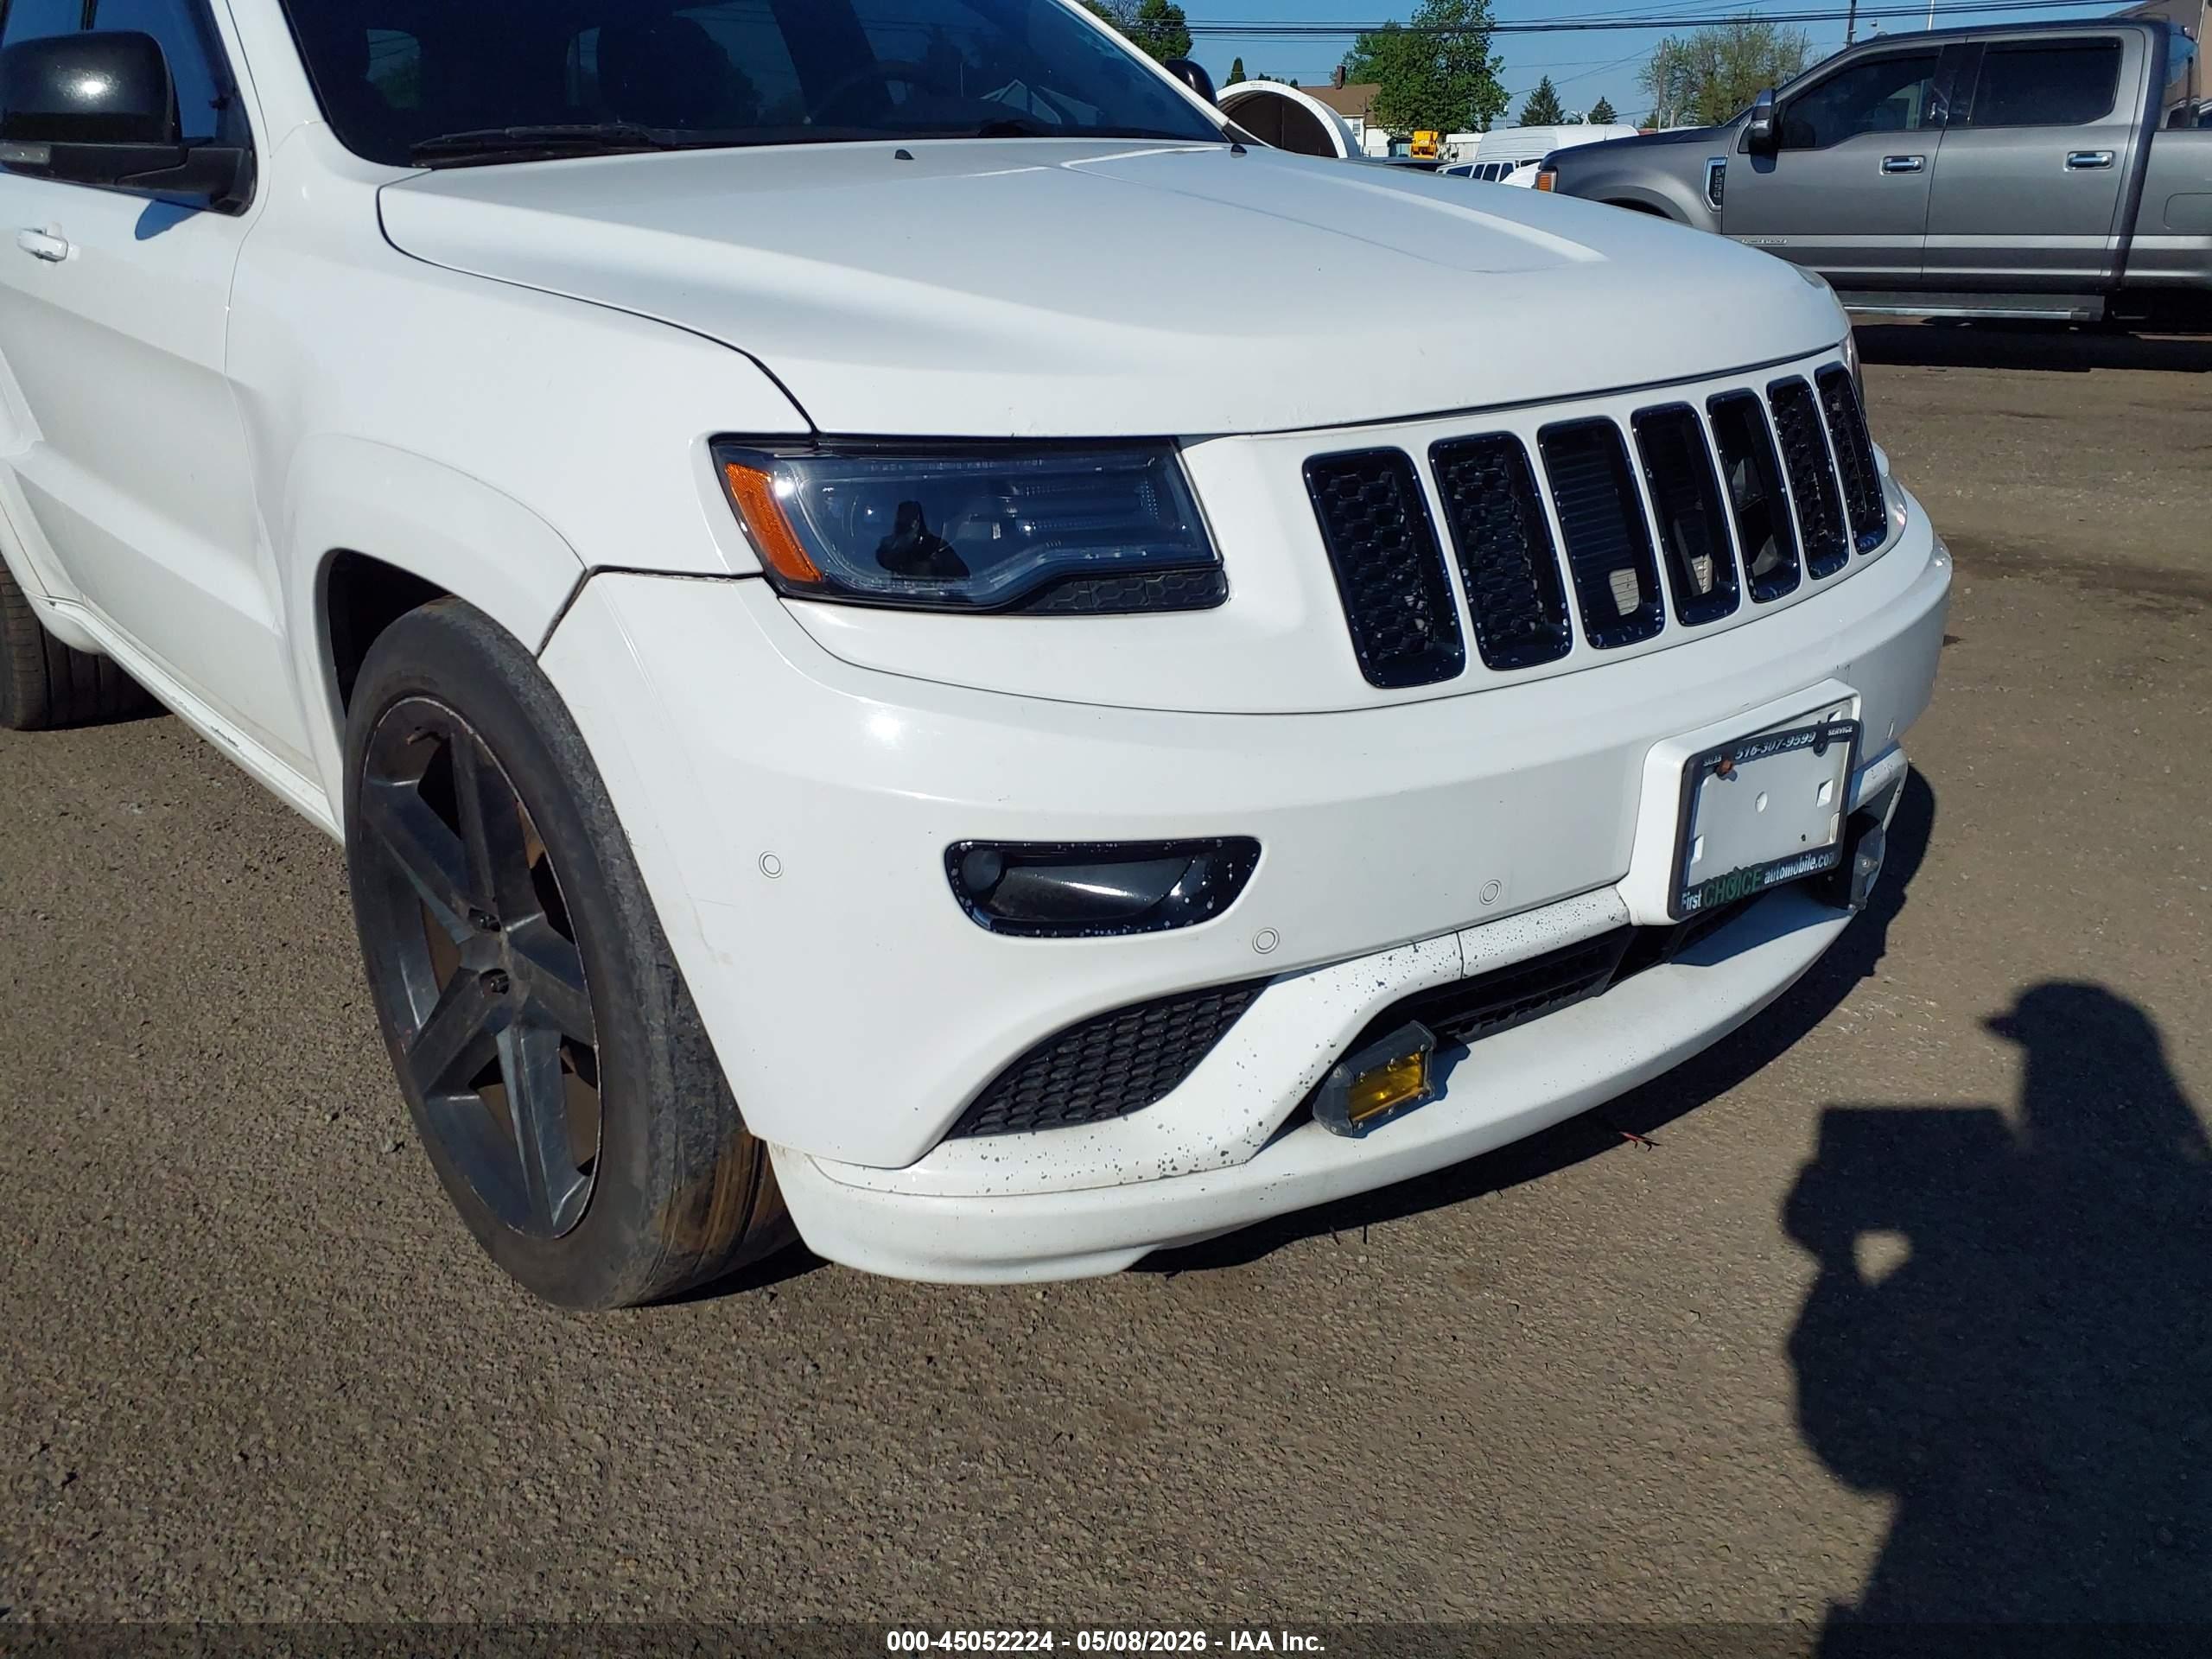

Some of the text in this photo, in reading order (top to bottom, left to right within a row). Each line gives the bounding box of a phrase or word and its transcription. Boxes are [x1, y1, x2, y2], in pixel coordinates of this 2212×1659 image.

[1827, 727, 1853, 736] SERVICE
[1681, 888, 1702, 910] First
[1704, 868, 1761, 906] CHOICE
